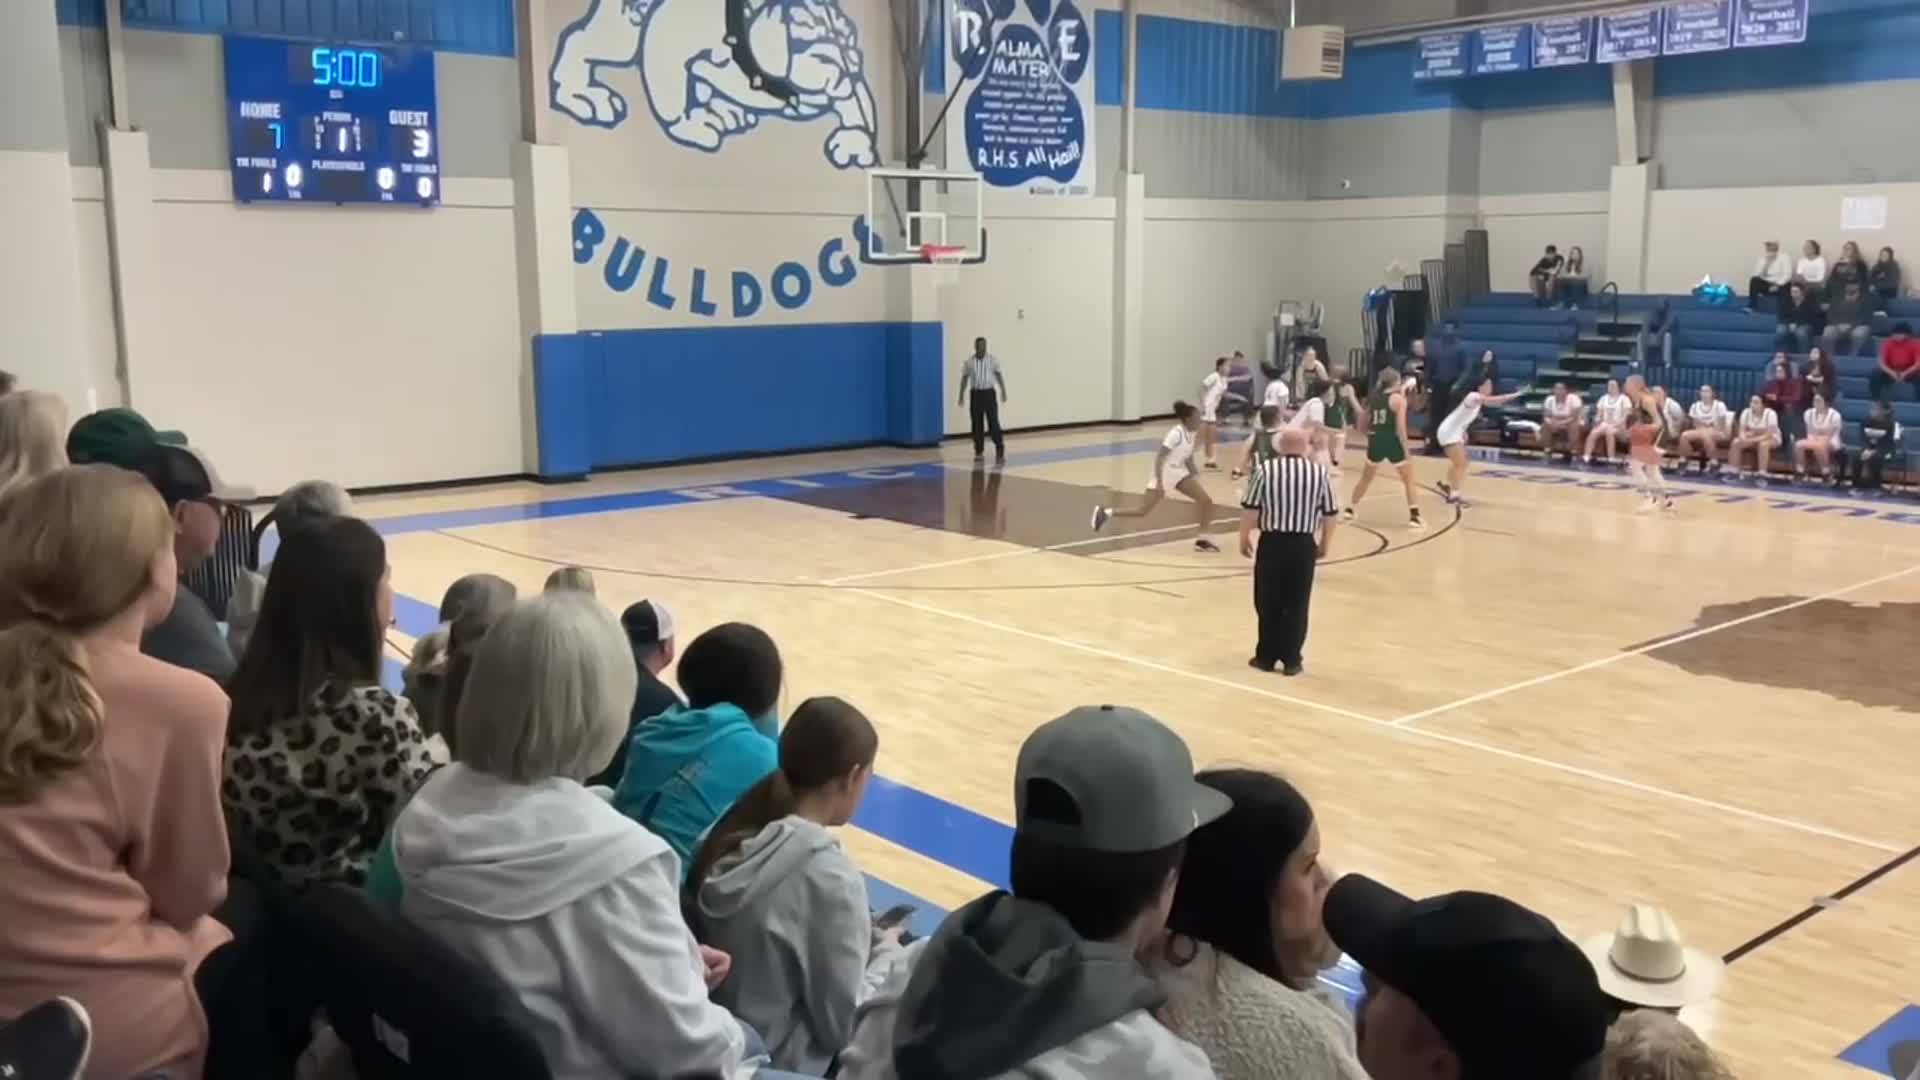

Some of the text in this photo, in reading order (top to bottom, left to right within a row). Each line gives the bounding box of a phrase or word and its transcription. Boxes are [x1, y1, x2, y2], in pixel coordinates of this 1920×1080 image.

[996, 40, 1044, 58] ALMA
[1057, 19, 1081, 60] E
[312, 49, 377, 87] 5:00
[992, 57, 1048, 77] MATER
[389, 110, 429, 126] GUEST
[268, 123, 281, 150] 7
[338, 127, 347, 152] 1
[413, 129, 430, 158] 3
[285, 163, 301, 187] 0
[377, 167, 394, 190] 0
[417, 176, 432, 198] 0
[571, 207, 884, 318] BULLDOGS
